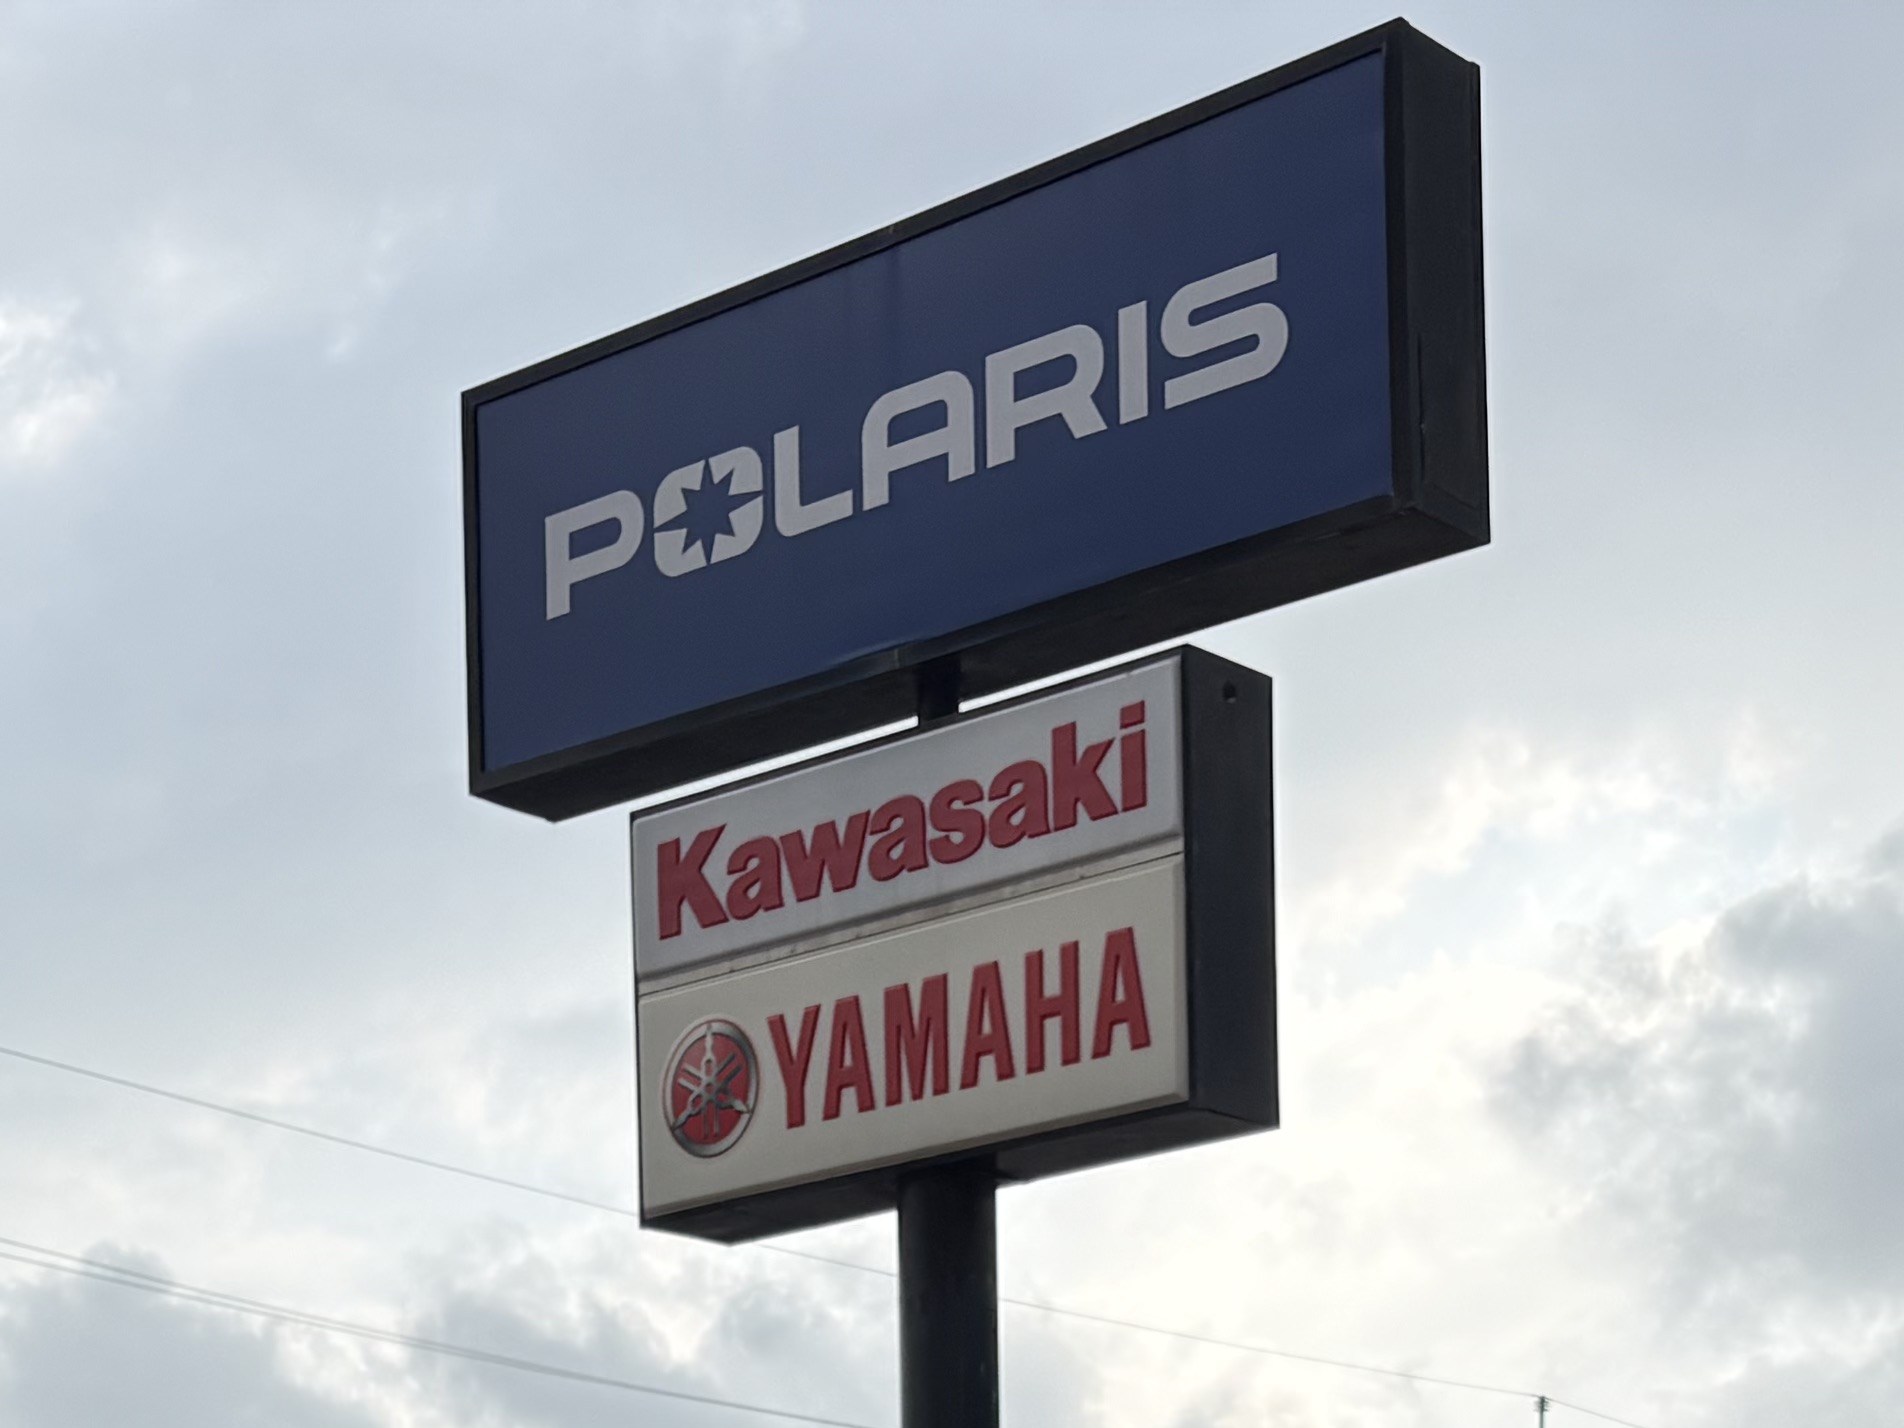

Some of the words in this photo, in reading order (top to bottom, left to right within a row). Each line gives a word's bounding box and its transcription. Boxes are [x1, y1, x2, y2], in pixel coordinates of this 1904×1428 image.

[545, 253, 1289, 620] POLARIS
[656, 700, 1148, 940] Kawasaki
[765, 926, 1151, 1129] YAMAHA
